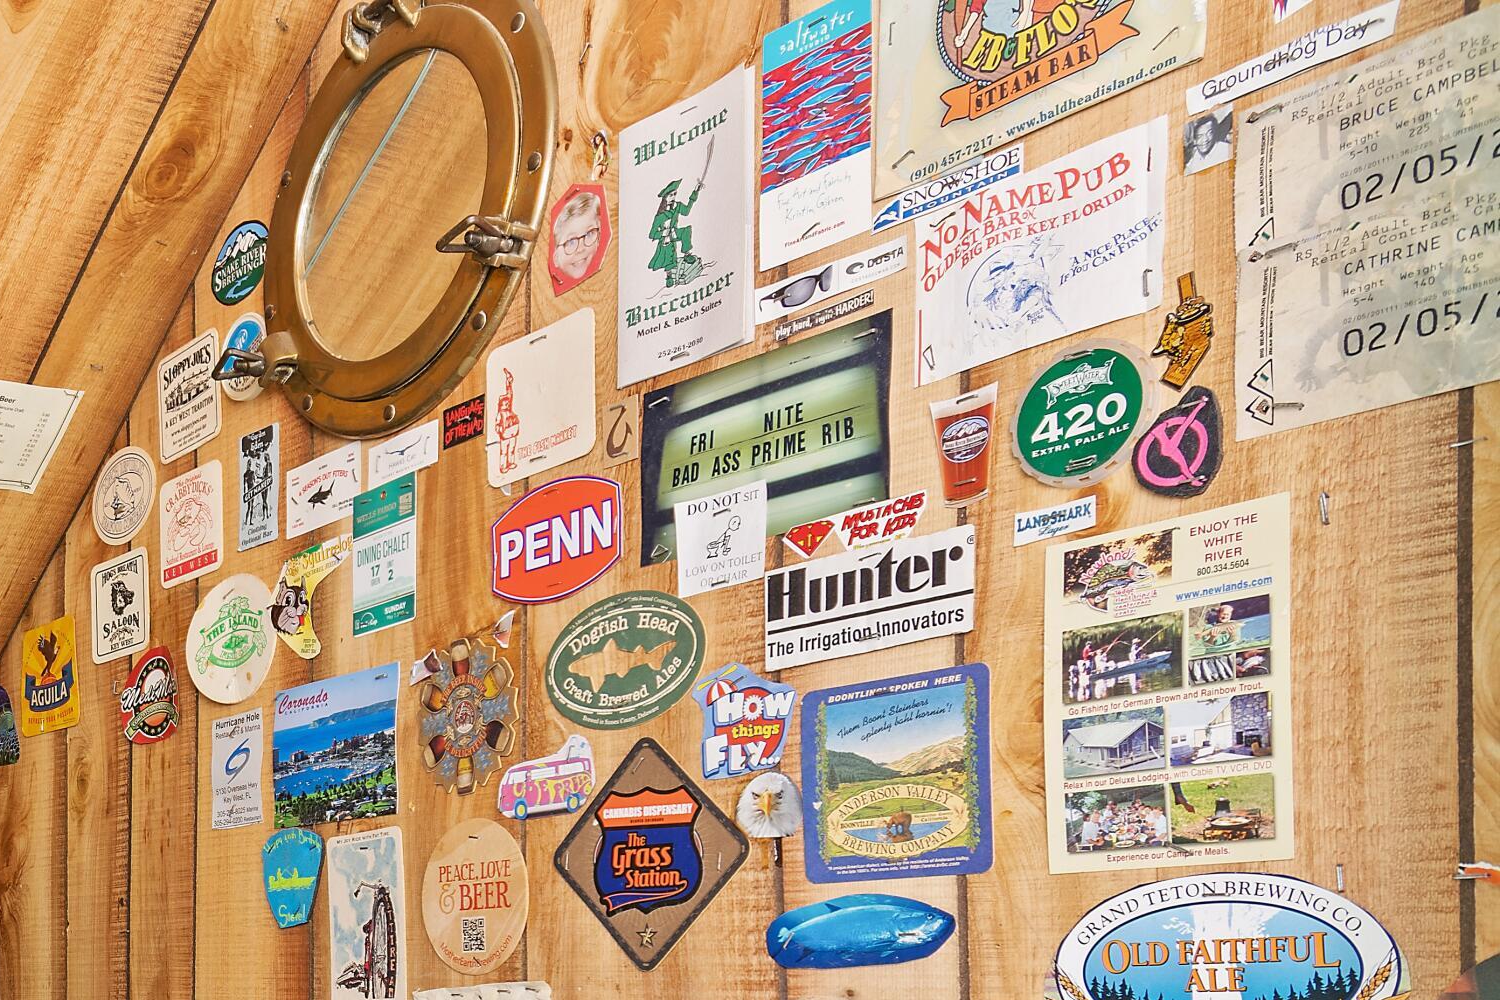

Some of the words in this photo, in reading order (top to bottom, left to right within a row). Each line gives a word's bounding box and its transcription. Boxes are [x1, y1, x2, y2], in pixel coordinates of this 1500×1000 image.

[780, 10, 855, 53] saltwater
[1202, 40, 1316, 98] Groundhog
[1327, 20, 1370, 46] Day
[974, 64, 1042, 113] STEAM
[1049, 45, 1093, 77] BAR
[910, 161, 939, 183] (910)
[940, 135, 994, 168] 457-7217
[1006, 54, 1178, 138] www.baldheadisland.com
[1340, 98, 1398, 130] BRUCE
[634, 107, 728, 167] Welcome
[903, 148, 1020, 209] SNOWSHOE
[912, 172, 1009, 214] MOUNTAIN
[960, 183, 1056, 236] NAME
[1055, 153, 1131, 200] PUB
[961, 244, 984, 270] BIG
[986, 226, 1021, 251] PINE
[1027, 216, 1060, 237] KEY,
[1063, 184, 1136, 226] FLORIDA
[222, 257, 260, 287] BREWING
[1344, 236, 1440, 276] CATHRINE
[215, 260, 239, 293] SNAKE
[625, 271, 734, 328] Buccaneer
[776, 326, 791, 340] play
[835, 291, 874, 316] HARDER!
[637, 323, 661, 339] Motel
[664, 319, 671, 329] &
[674, 311, 697, 326] Beach
[701, 299, 722, 316] Suites
[658, 337, 703, 359] 252-261-2030
[163, 354, 191, 388] SLOPPY
[191, 344, 211, 365] JOE'S
[690, 430, 714, 455] FRI
[764, 402, 804, 432] NITE
[1031, 392, 1127, 443] 420
[672, 462, 699, 487] BAD
[712, 450, 741, 477] ASS
[752, 430, 806, 466] PRIME
[822, 417, 854, 446] RIB
[1032, 442, 1070, 458] EXTRA
[1074, 432, 1104, 446] PALE
[1107, 423, 1129, 435] ALE
[687, 501, 707, 516] DO
[712, 491, 741, 511] NOT
[743, 489, 759, 502] SIT
[841, 492, 925, 531] MUSTACHES
[1017, 503, 1091, 532] LANDSHARK
[500, 500, 612, 578] PENN
[848, 523, 877, 546] FOR
[883, 512, 917, 539] KIDS
[1190, 520, 1230, 536] ENJOY
[1234, 513, 1258, 526] THE
[1204, 532, 1242, 548] WHITE
[357, 545, 381, 568] DINING
[383, 532, 410, 557] CHALET
[1205, 546, 1242, 563] RIVER
[767, 546, 963, 622] Hunter
[1197, 559, 1249, 576] 800.334.5604
[1176, 575, 1272, 601] www.newlands.com
[103, 612, 140, 638] SALOON
[569, 615, 628, 655] Dogfish
[637, 613, 679, 636] Head
[768, 640, 794, 658] The
[800, 626, 871, 652] Irrigation
[877, 606, 964, 639] Innovators
[32, 681, 67, 707] AGUILA
[563, 678, 593, 704] Craft
[600, 686, 649, 707] Brewed
[655, 656, 682, 688] Ales
[890, 680, 928, 693] SPOKEN
[934, 674, 962, 685] HERE
[278, 689, 329, 715] Coronado
[715, 690, 794, 723] HOW
[216, 716, 244, 730] Hurricane
[246, 713, 259, 722] Hole
[732, 724, 780, 739] things
[603, 807, 642, 819] CANNABIS
[643, 803, 692, 816] DISPENSARY
[839, 788, 900, 818] ANDERSON
[907, 785, 953, 805] VALLEY
[628, 833, 646, 846] The
[841, 835, 896, 855] BREWING
[900, 827, 954, 854] COMPANY
[439, 864, 478, 882] PEACE,
[481, 860, 511, 878] LOVE
[613, 845, 671, 875] Grass
[626, 869, 680, 888] Station
[440, 884, 455, 914] &
[459, 881, 511, 910] BEER
[1077, 897, 1139, 946] GRAND
[1143, 882, 1218, 906] TETON
[1225, 880, 1328, 913] BREWING
[1332, 906, 1362, 937] CO.
[1101, 939, 1169, 975] OLD
[1176, 931, 1342, 968] FAITHFUL
[1185, 967, 1247, 993] ALE
